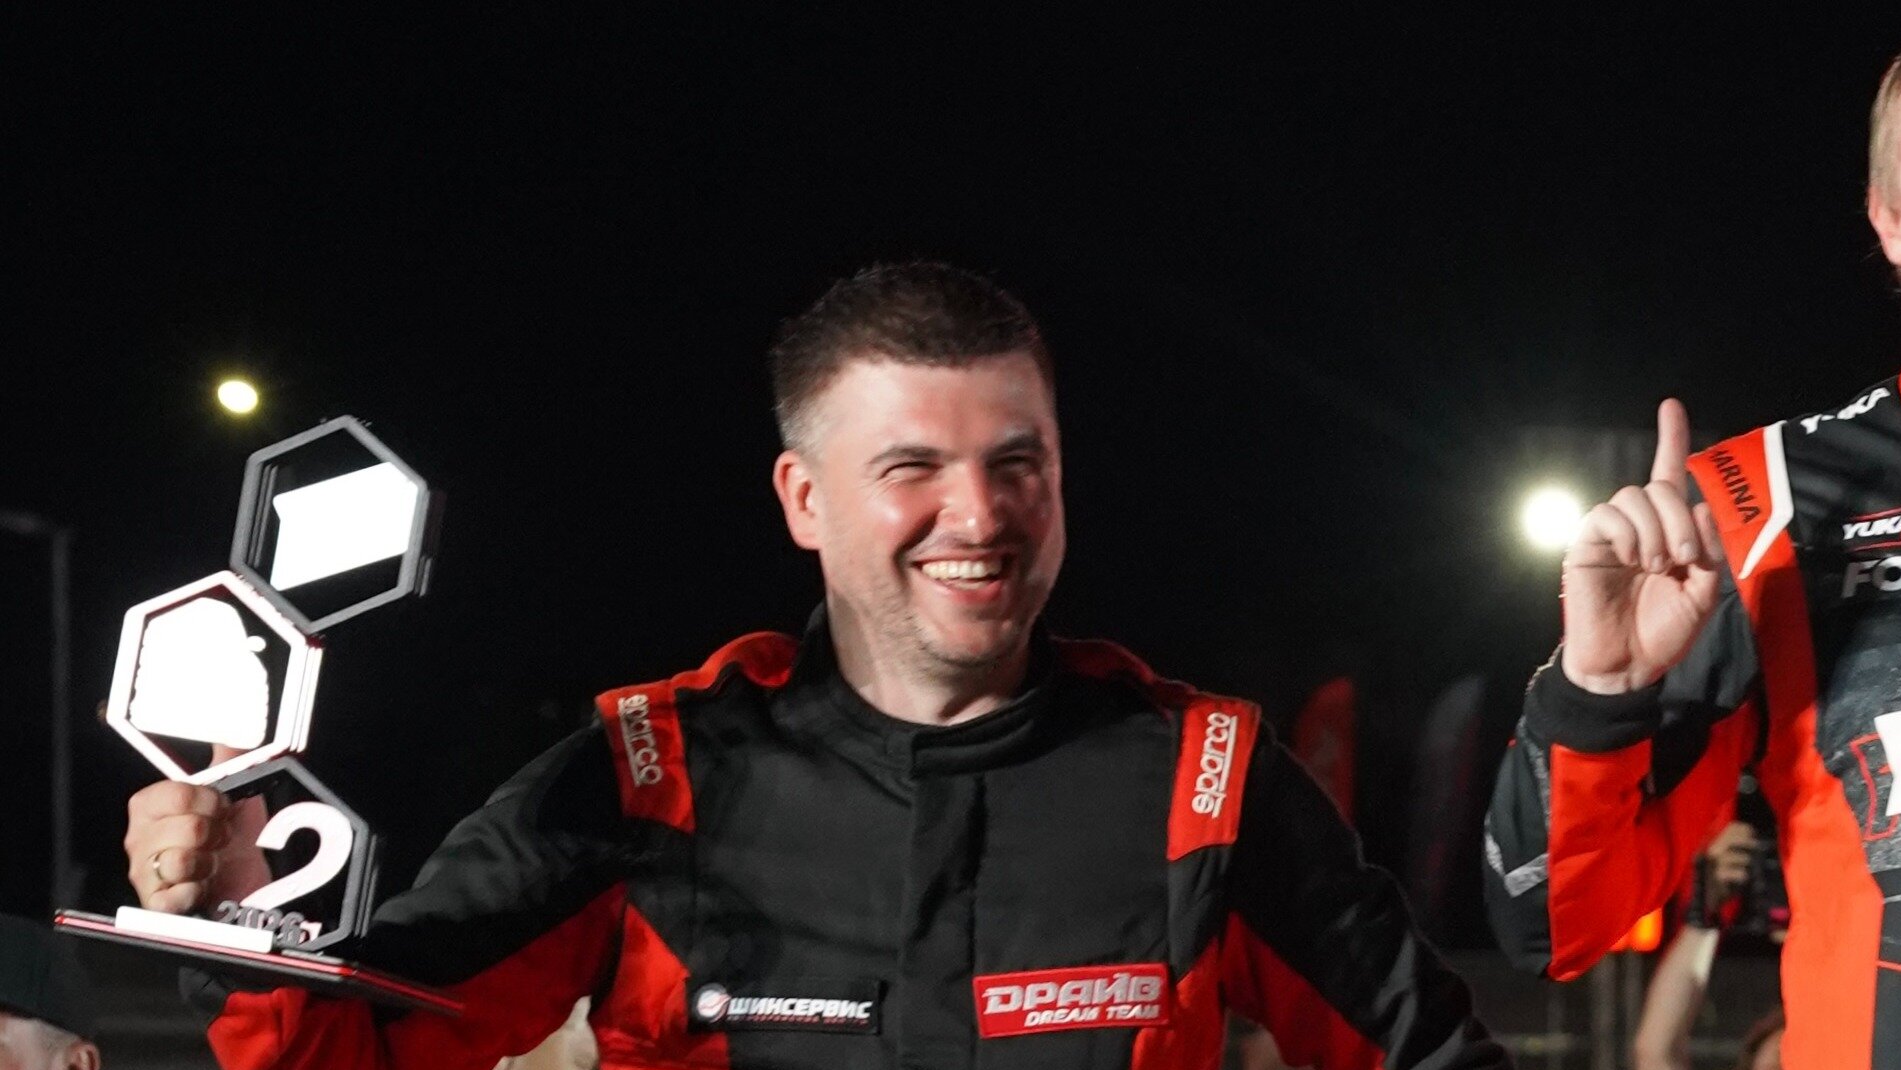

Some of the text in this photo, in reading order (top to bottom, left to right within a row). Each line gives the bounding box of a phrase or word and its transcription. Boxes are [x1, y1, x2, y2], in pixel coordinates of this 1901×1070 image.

[618, 694, 664, 787] sparco
[1191, 712, 1239, 820] sparco
[240, 801, 354, 911] 2
[727, 997, 874, 1019] ШИНСЕРВИС
[1024, 1004, 1160, 1027] DREAM TEAM
